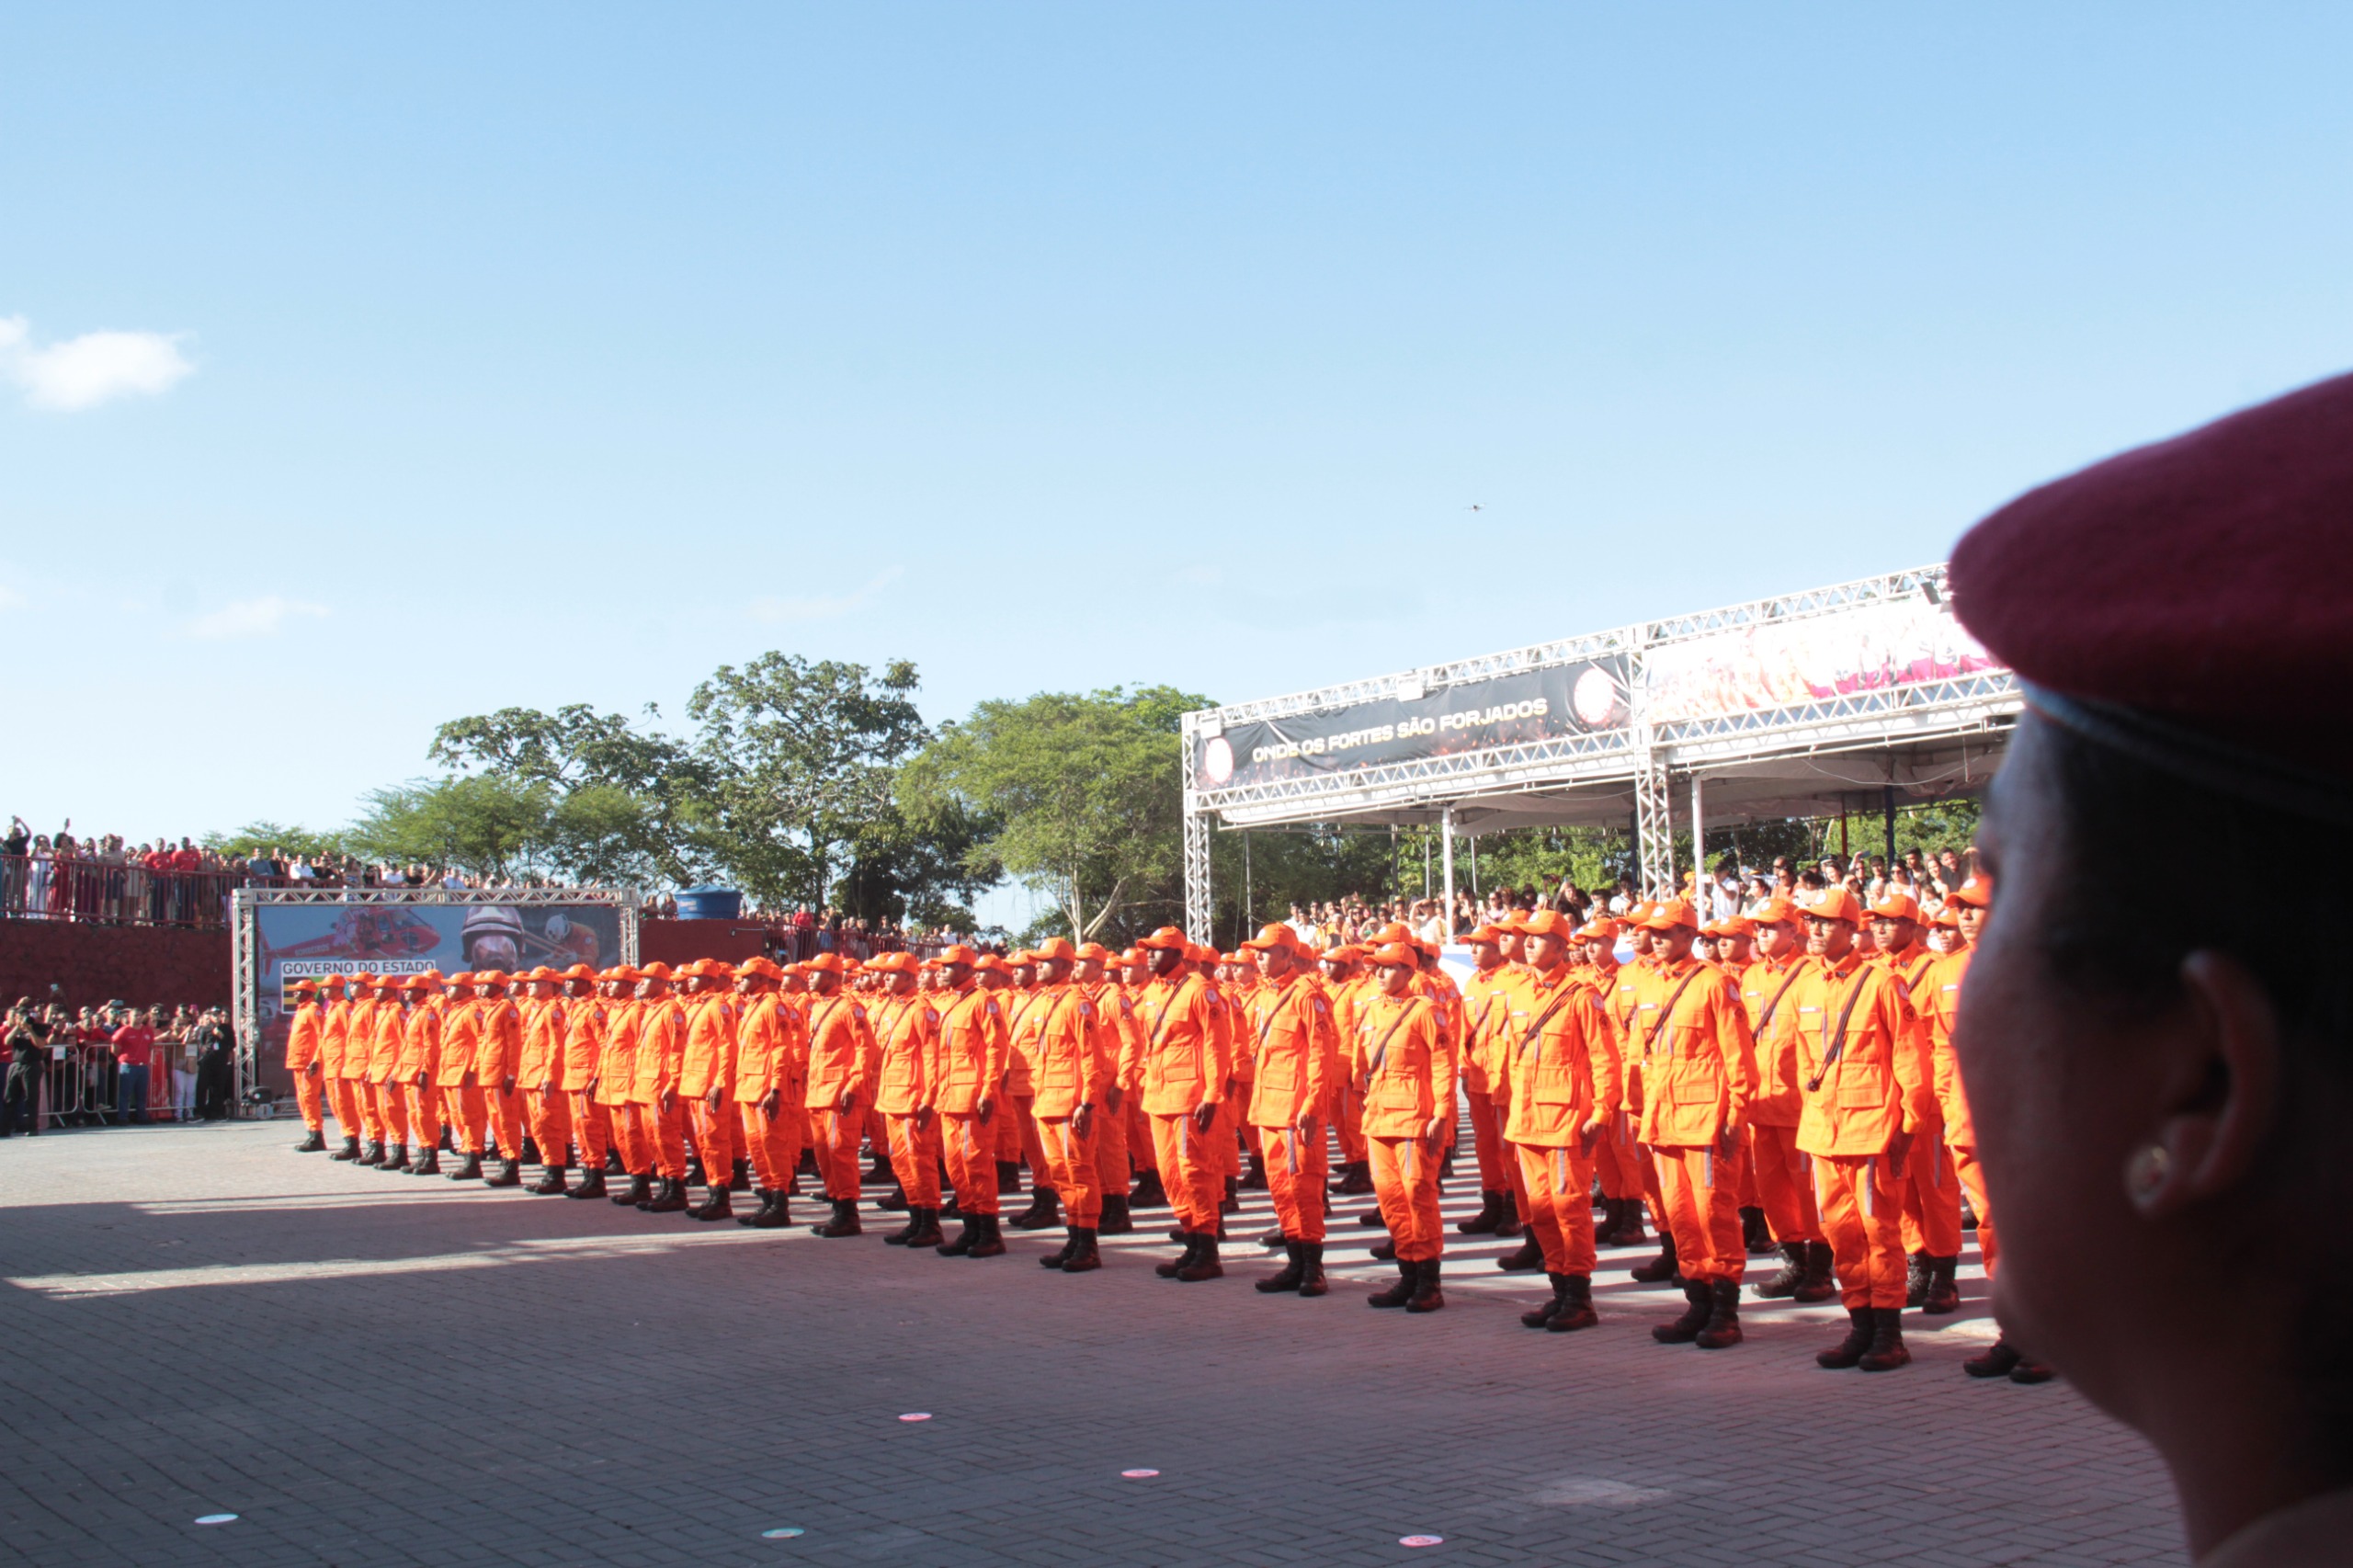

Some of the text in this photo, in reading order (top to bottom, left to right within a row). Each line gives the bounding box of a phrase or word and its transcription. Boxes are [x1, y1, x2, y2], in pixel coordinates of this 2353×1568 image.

[1252, 698, 1548, 763] ONDE OS FORTES SÃO FORJADOS
[282, 960, 435, 974] GOVERNO DO ESTADO
